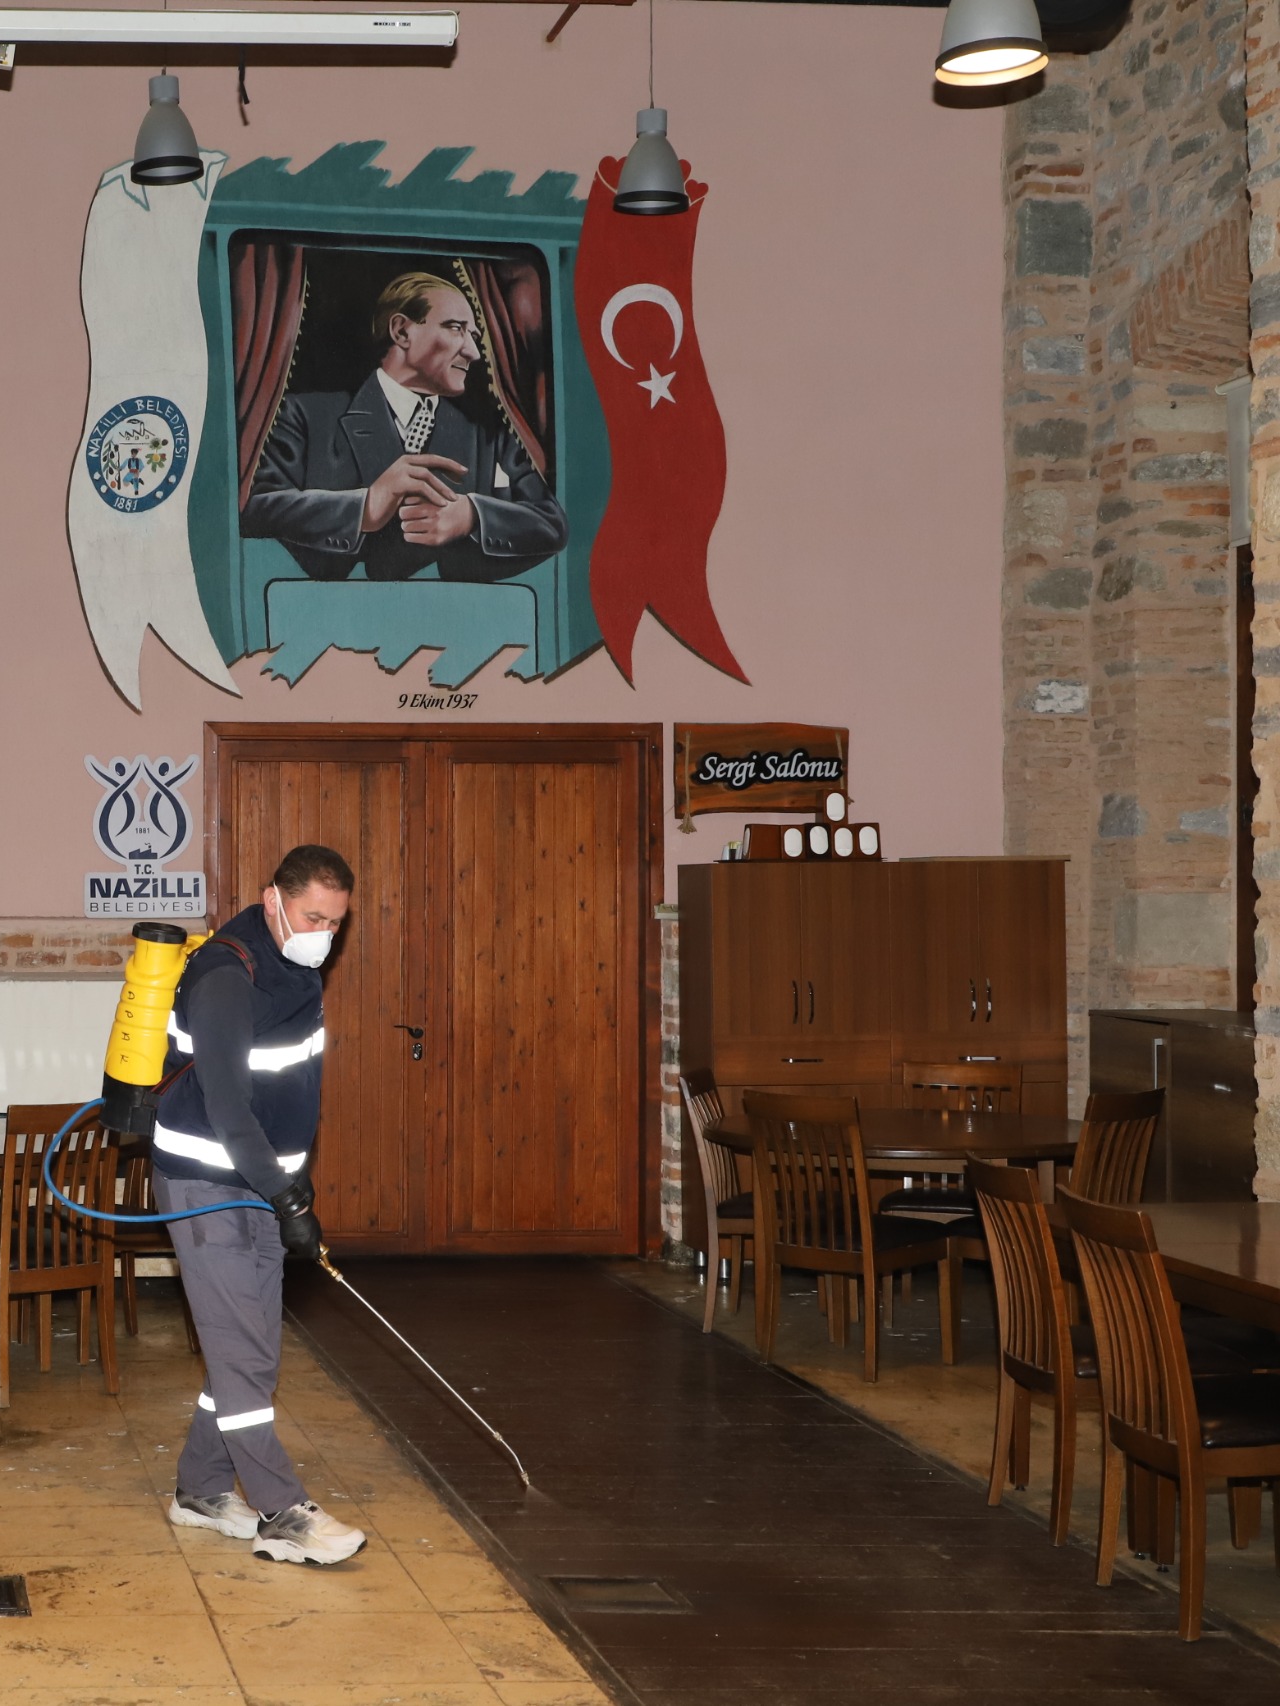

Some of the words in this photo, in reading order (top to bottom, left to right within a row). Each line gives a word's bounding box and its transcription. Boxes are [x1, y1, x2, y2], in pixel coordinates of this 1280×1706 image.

[113, 497, 138, 512] 1881
[397, 693, 409, 709] 9
[410, 693, 445, 710] Ekim
[446, 693, 479, 709] 1937
[699, 754, 758, 787] Sergi
[759, 752, 839, 781] Salonu
[134, 864, 155, 875] T.C.
